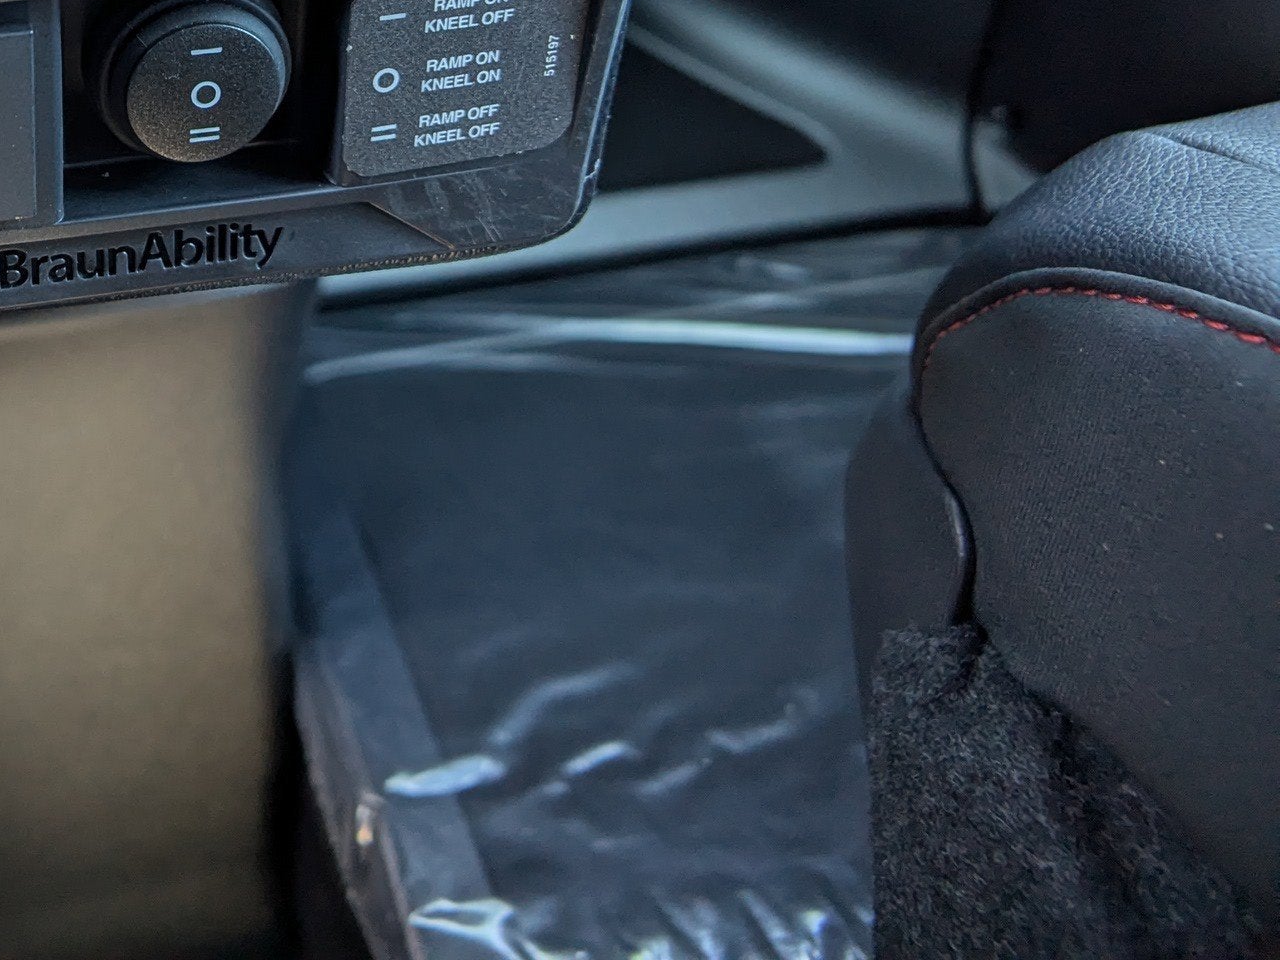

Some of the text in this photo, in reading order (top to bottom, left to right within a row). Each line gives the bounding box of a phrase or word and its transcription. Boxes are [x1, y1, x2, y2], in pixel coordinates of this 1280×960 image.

[424, 8, 515, 33] KNEEL OFF
[426, 49, 500, 73] RAMP ON
[543, 34, 560, 77] 515197
[420, 68, 501, 92] KNEEL ON
[418, 103, 500, 128] RAMP OFF
[413, 122, 501, 148] KNEEL OFF
